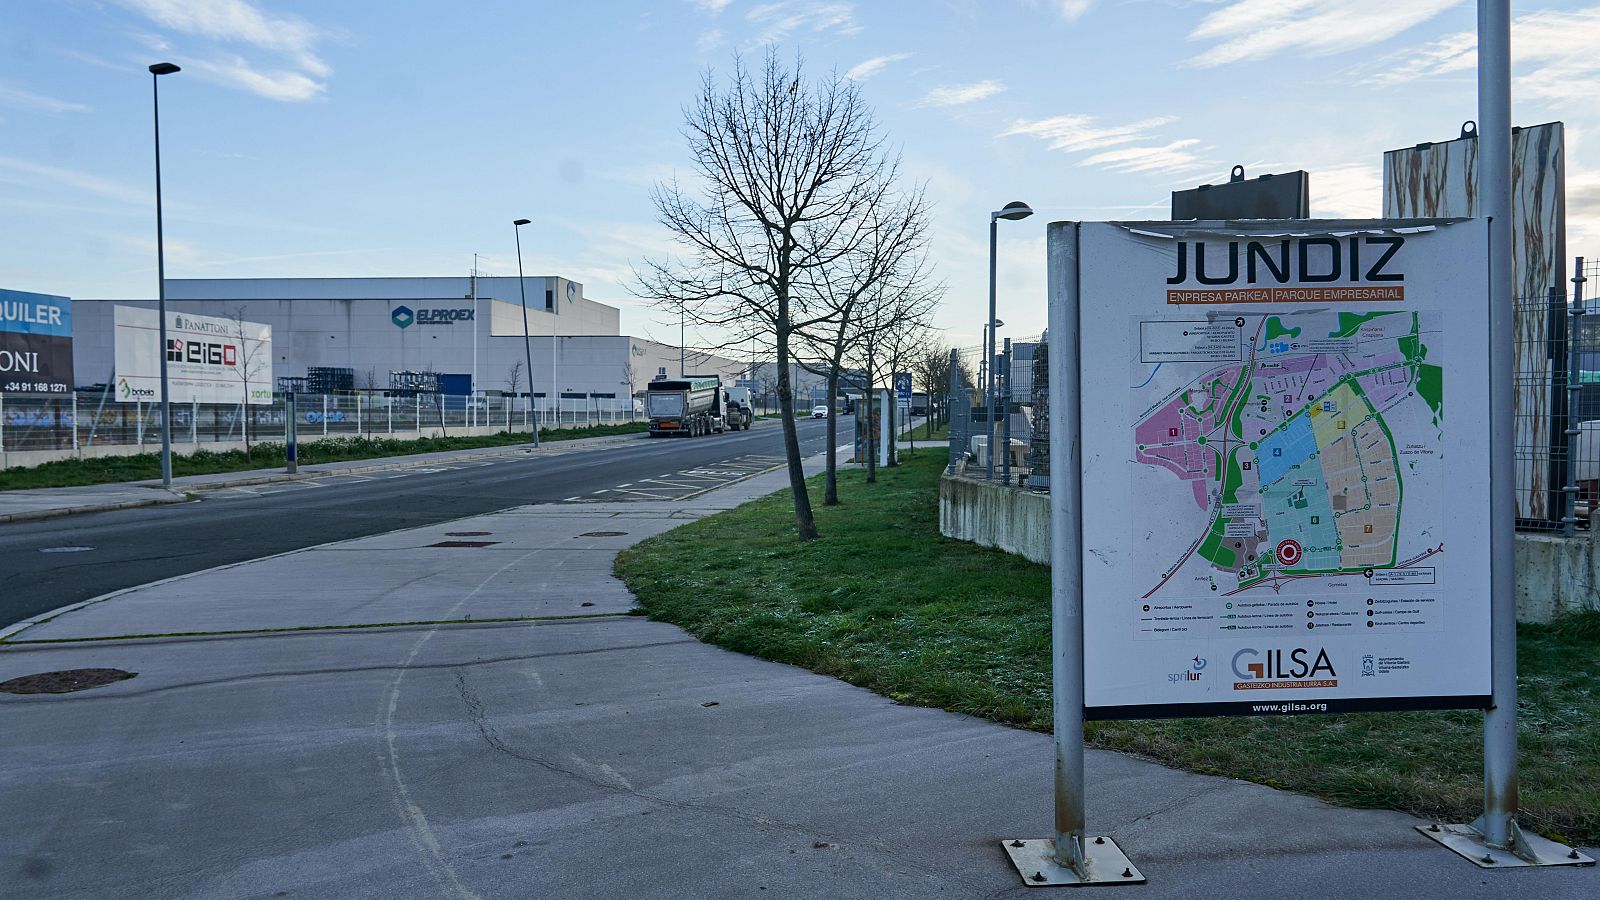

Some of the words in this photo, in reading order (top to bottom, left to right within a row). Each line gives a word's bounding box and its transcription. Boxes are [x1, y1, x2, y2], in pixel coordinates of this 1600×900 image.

[1166, 236, 1405, 285] JUNDIZ
[1169, 292, 1222, 302] ENPRESA
[1225, 291, 1269, 301] PARKEA
[1275, 290, 1321, 300] PARQUE
[1324, 289, 1401, 300] EMPRESARIAL
[0, 301, 62, 326] UILER
[416, 309, 475, 320] ELPROEX
[184, 319, 229, 334] PANATTONI
[4, 382, 20, 392] +34
[21, 383, 31, 392] 91
[34, 383, 48, 392] 168
[50, 384, 68, 392] 1271
[1231, 647, 1336, 679] GILSA
[1168, 670, 1202, 684] sprilur
[1252, 702, 1327, 713] www.gilsa.org
